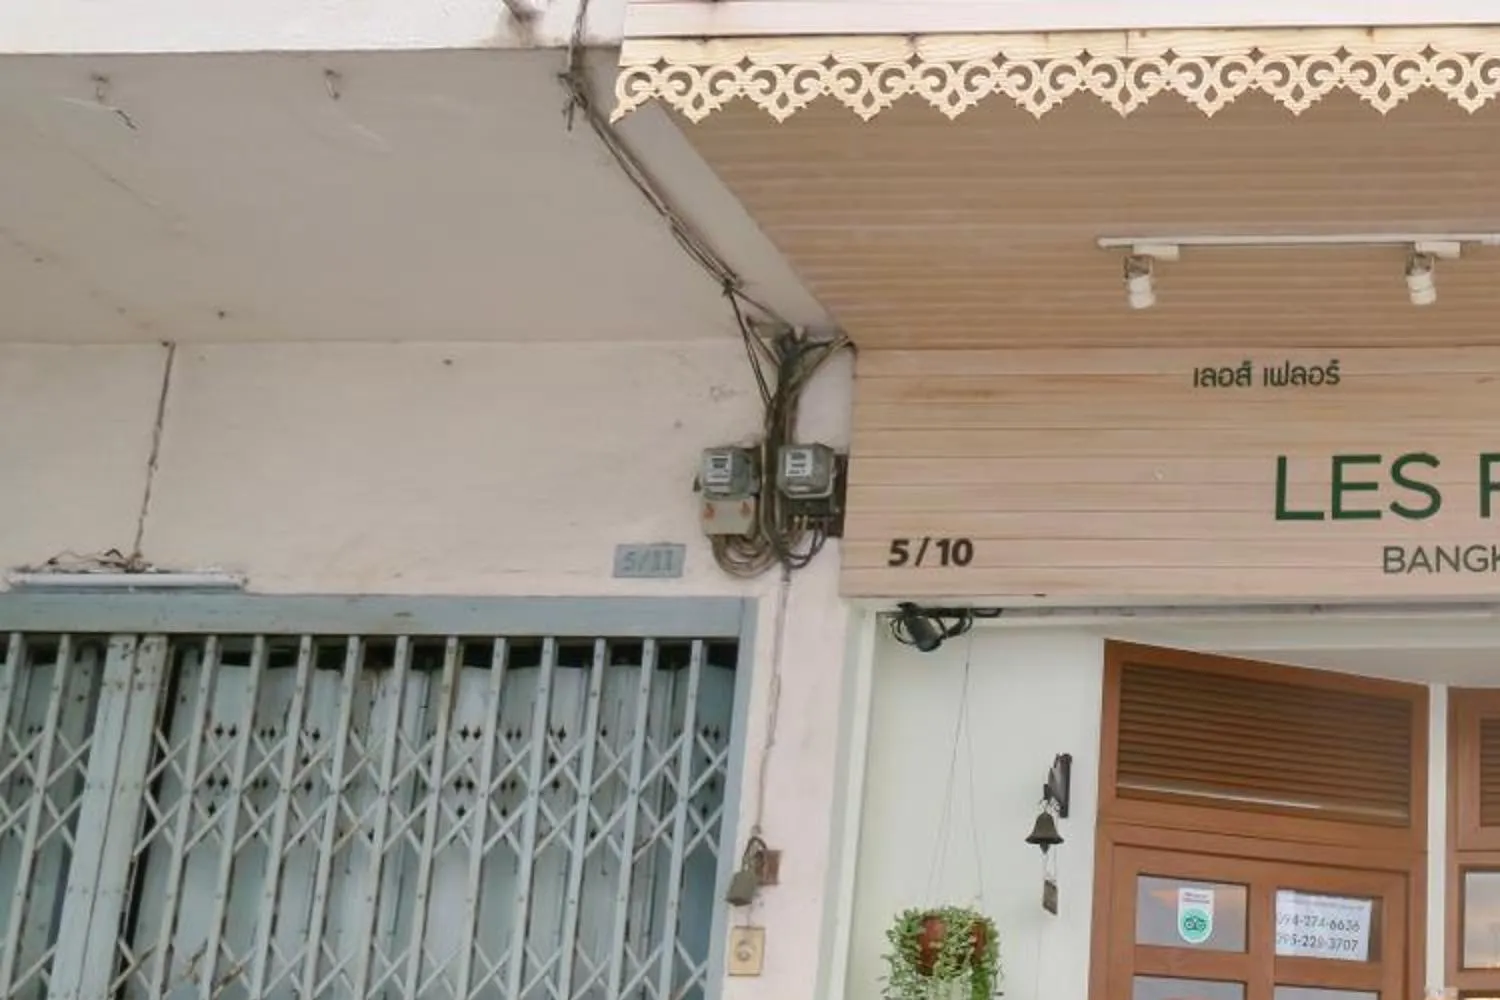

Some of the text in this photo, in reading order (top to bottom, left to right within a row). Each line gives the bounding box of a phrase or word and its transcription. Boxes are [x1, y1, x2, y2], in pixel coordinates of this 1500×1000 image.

[1193, 359, 1341, 388] เลอส์ เฟลอร์
[1275, 453, 1442, 521] LES
[622, 549, 674, 573] 5/11
[888, 536, 974, 567] 5/10
